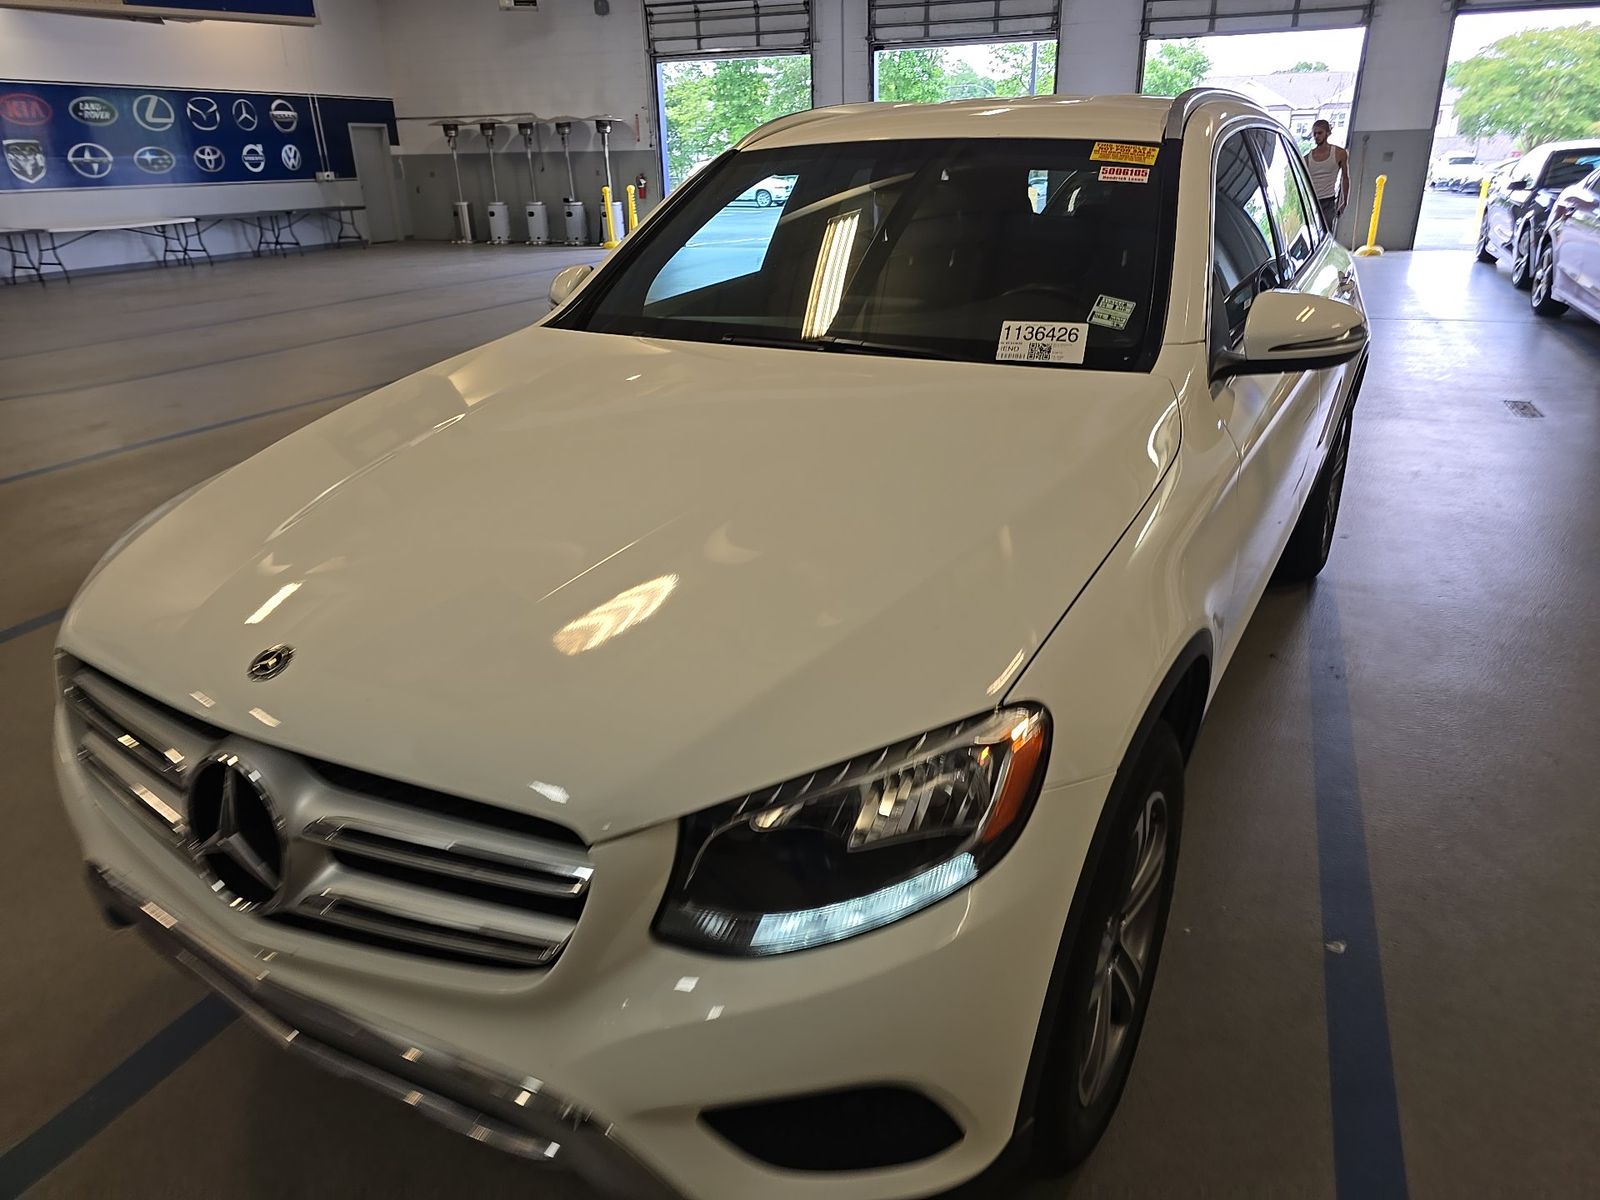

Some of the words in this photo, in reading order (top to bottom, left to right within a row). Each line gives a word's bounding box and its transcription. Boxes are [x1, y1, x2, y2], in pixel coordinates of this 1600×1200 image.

[79, 102, 102, 111] LAND
[83, 111, 111, 120] ROVER
[1004, 325, 1079, 342] 1136426
